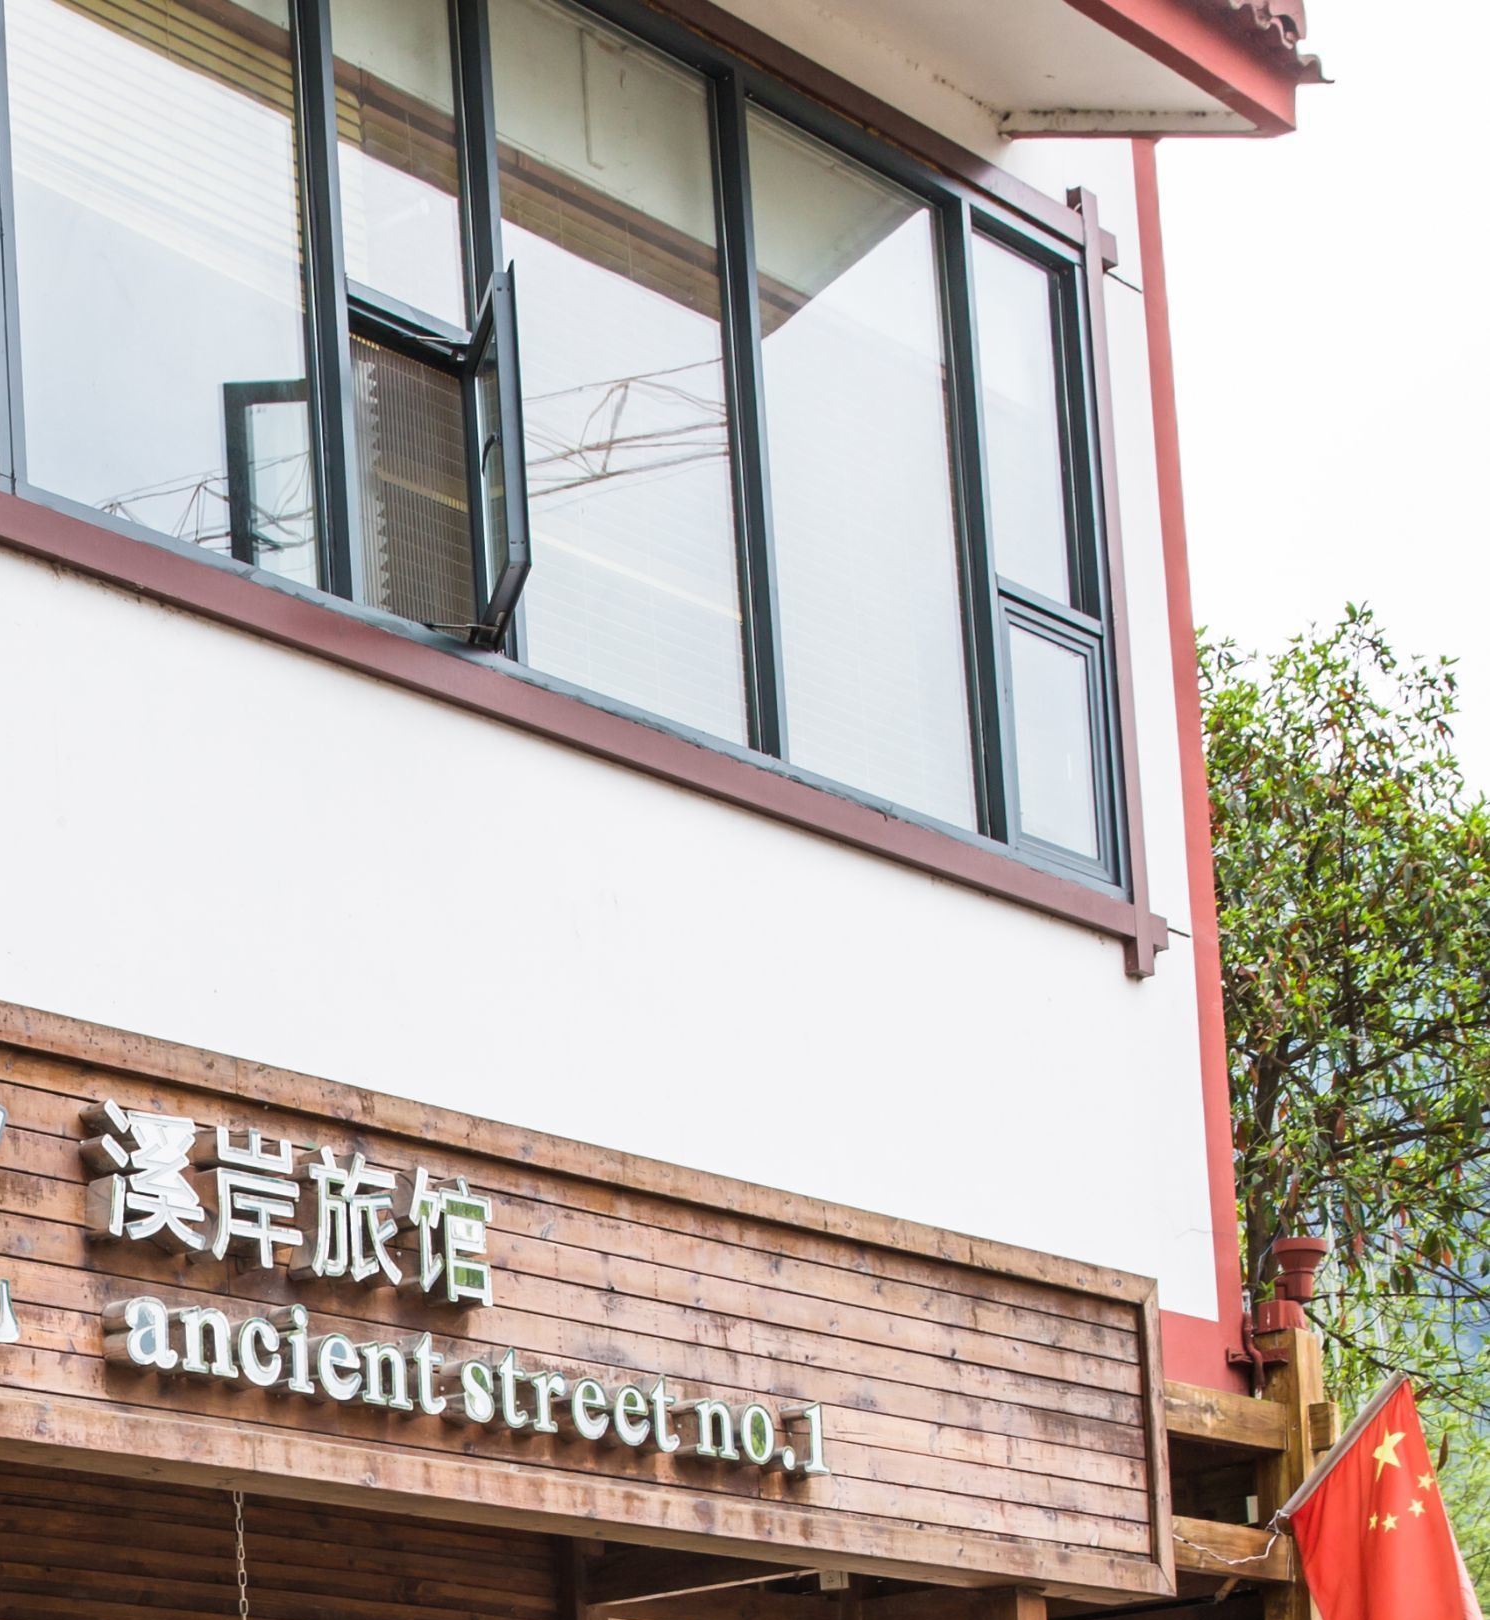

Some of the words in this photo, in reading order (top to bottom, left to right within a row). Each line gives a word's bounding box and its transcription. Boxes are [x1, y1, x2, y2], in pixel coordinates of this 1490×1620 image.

[98, 1098, 494, 1308] 溪岸旅馆
[125, 1295, 447, 1417] ancient
[459, 1345, 682, 1454] street
[694, 1400, 833, 1477] no.1
